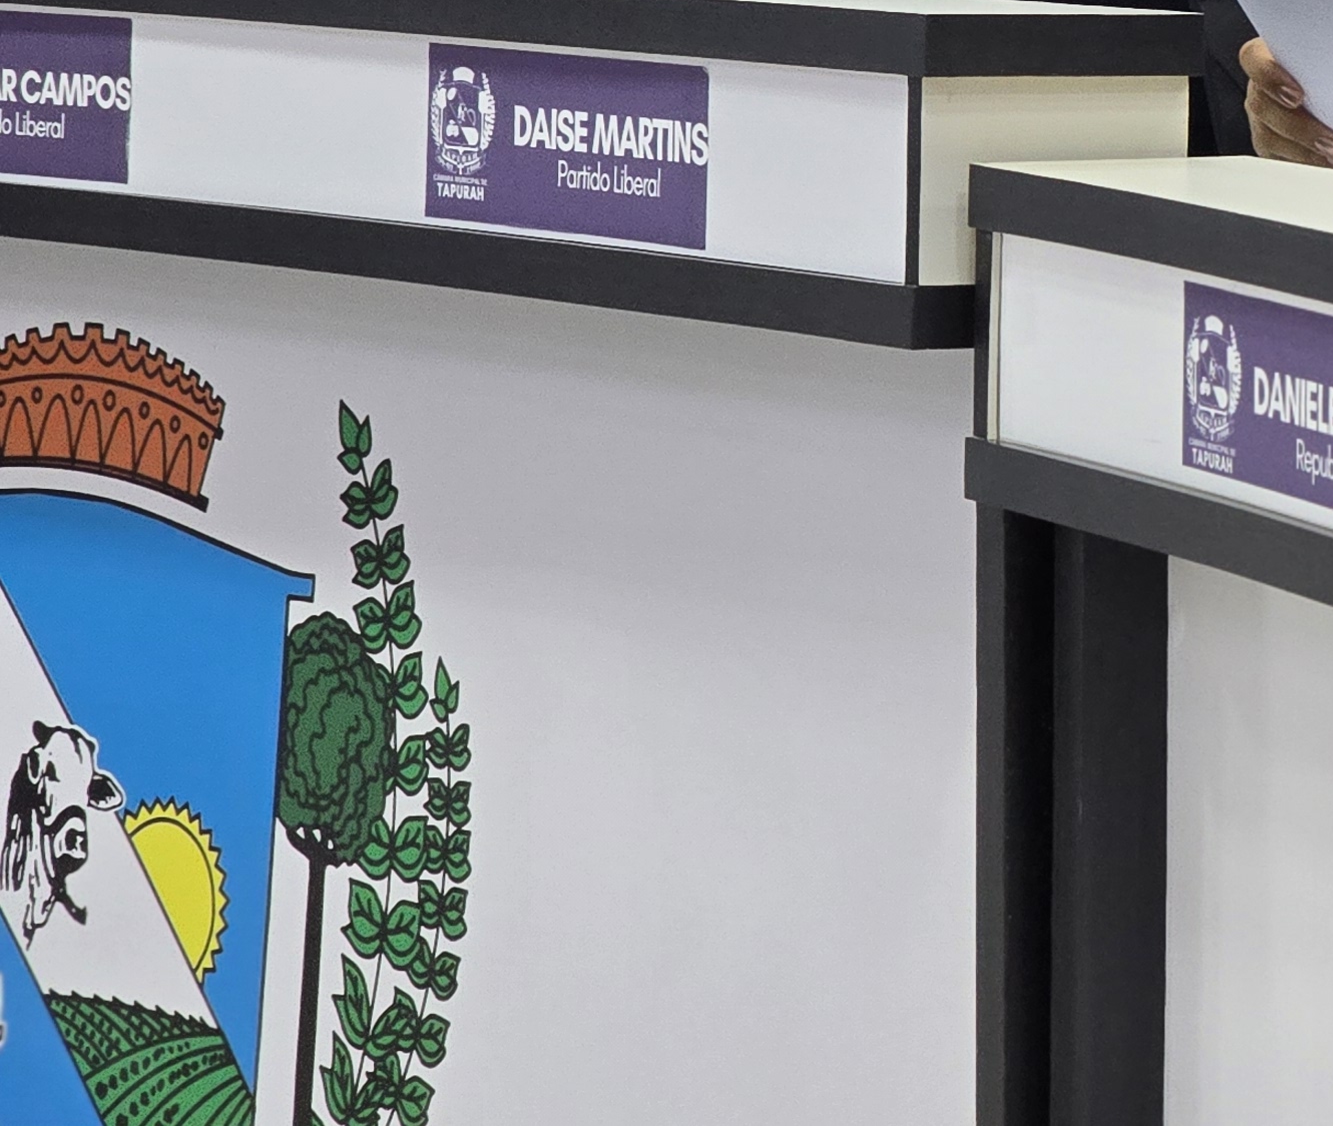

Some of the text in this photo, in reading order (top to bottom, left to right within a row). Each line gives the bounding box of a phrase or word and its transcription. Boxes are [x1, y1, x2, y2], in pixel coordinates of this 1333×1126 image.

[0, 68, 131, 111] R CAMPOS
[15, 109, 65, 139] Liberal
[513, 104, 708, 166] DAISE MARTINS
[437, 182, 484, 202] TAPURAH
[556, 159, 662, 198] Partido Liberal
[1191, 448, 1233, 474] TAPURAH
